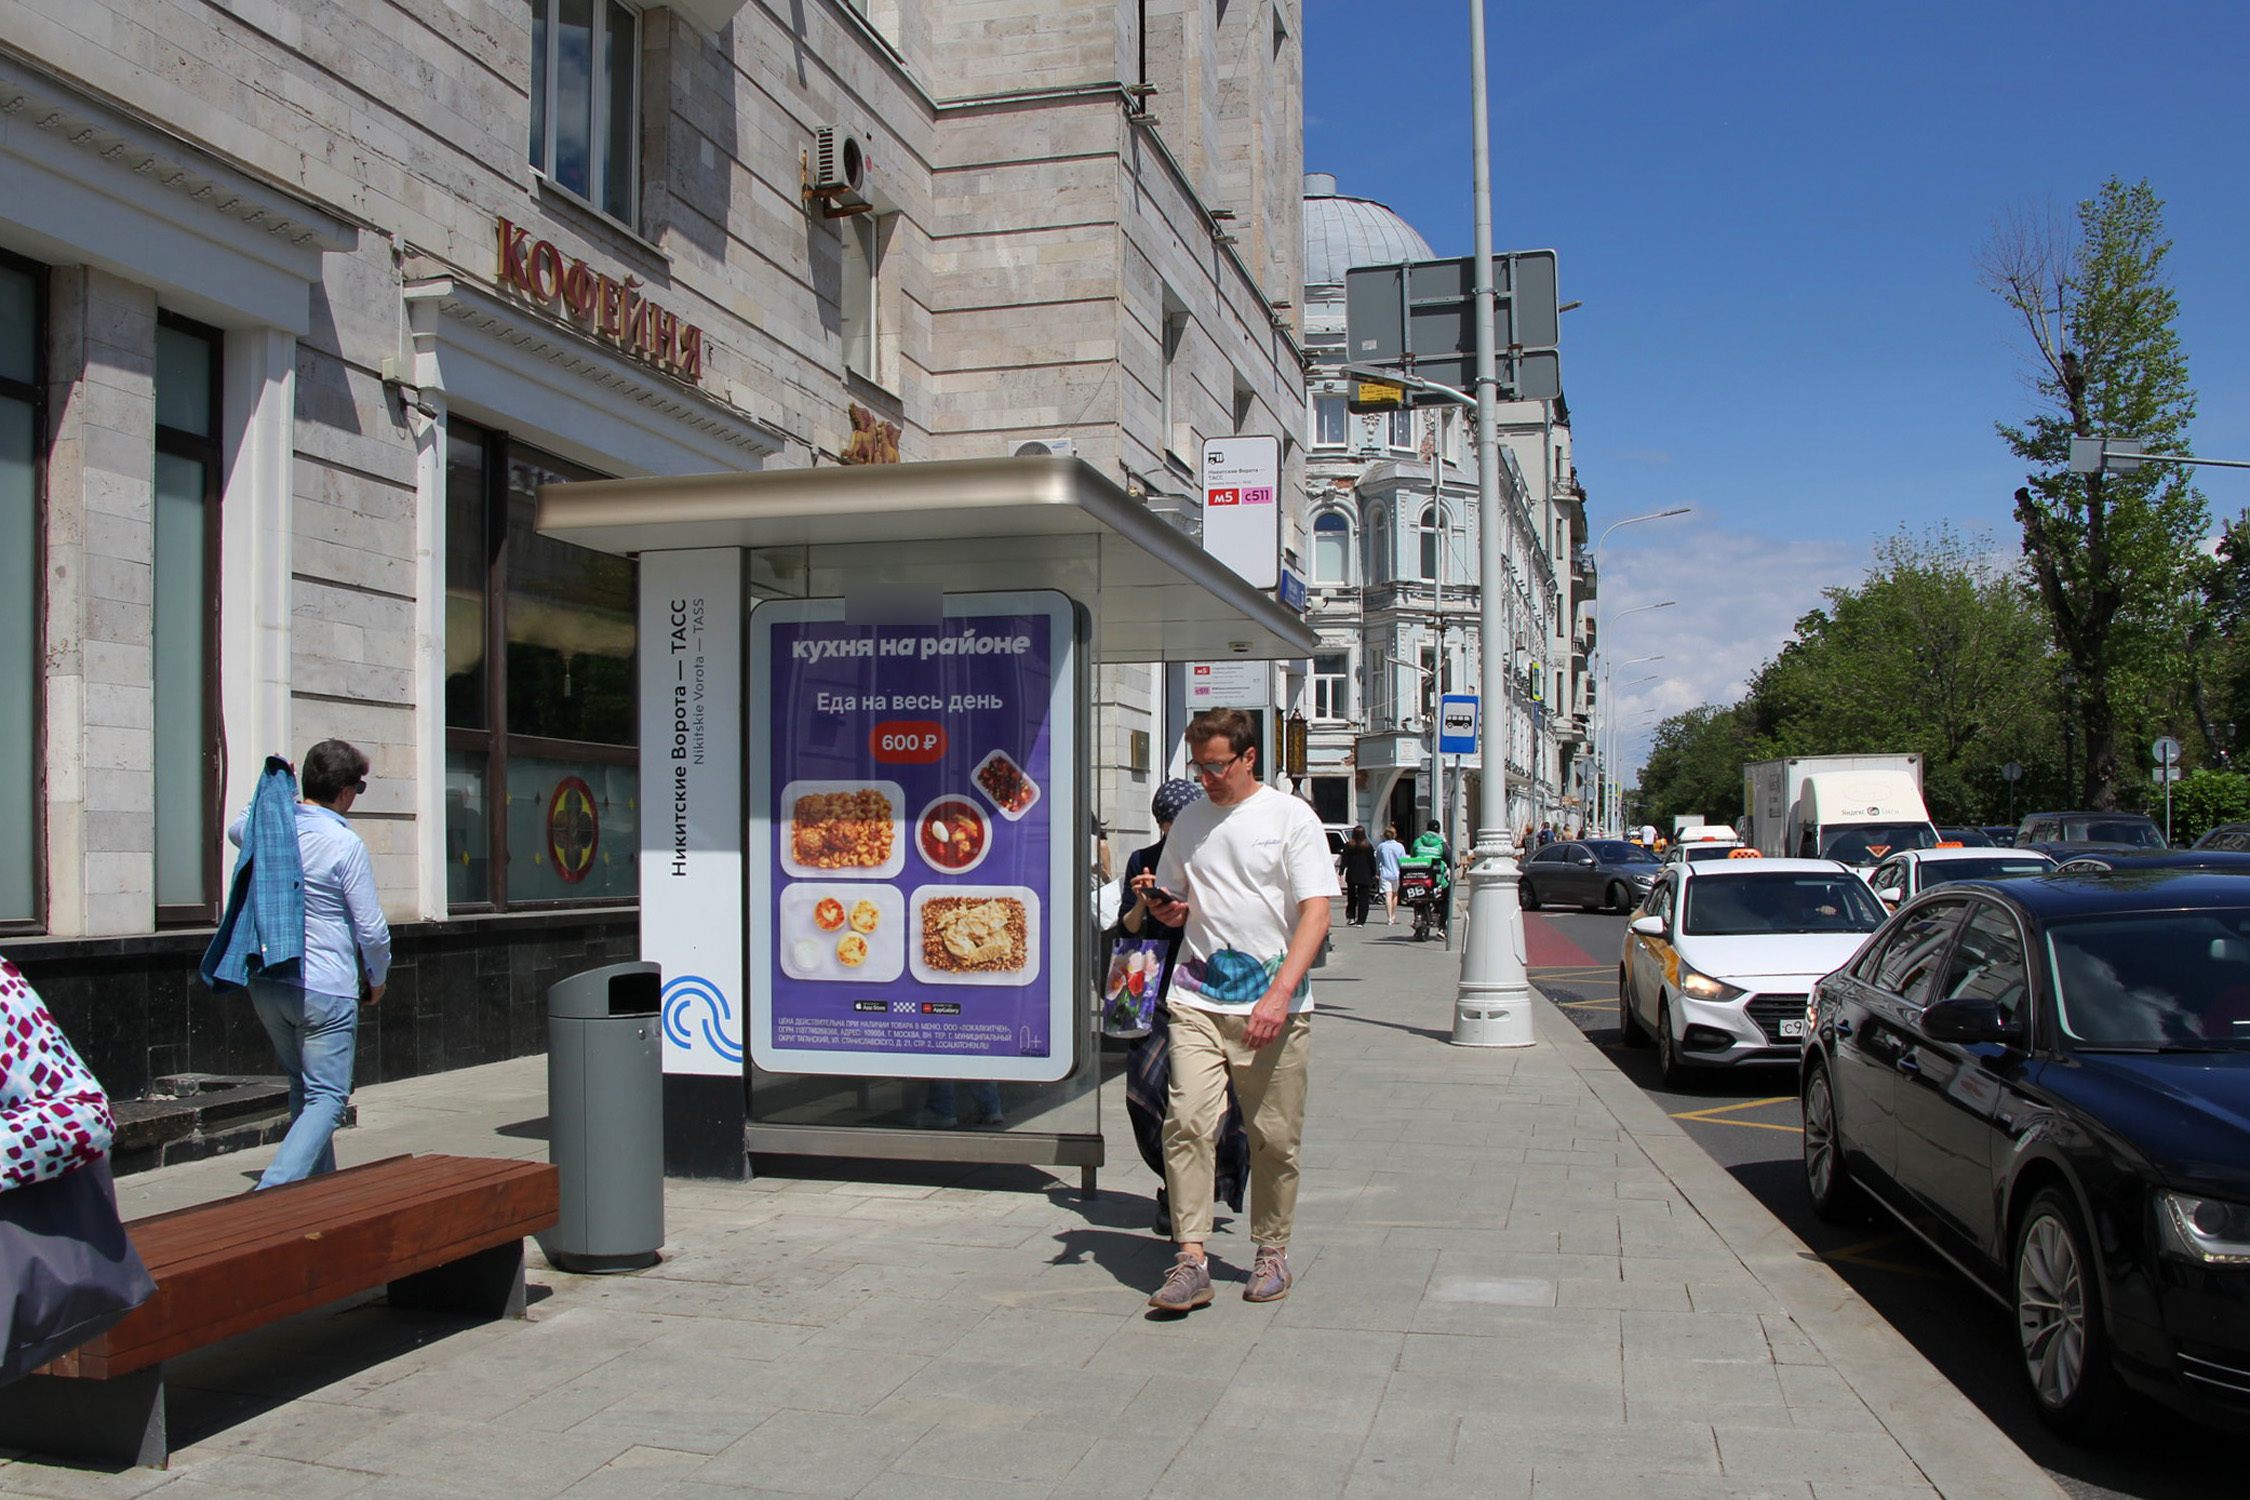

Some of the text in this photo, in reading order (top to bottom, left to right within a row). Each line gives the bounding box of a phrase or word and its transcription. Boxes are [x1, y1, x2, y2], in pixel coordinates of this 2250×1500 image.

[496, 216, 703, 383] КОФЕЙНЯ
[1245, 490, 1269, 501] с511
[671, 599, 687, 655] ТАСС
[693, 598, 705, 634] TASS
[792, 629, 1031, 664] кухня на районе
[693, 656, 705, 701] Vorota
[671, 686, 690, 759] Ворота
[817, 692, 1003, 714] Еда на весь день
[693, 705, 705, 766] Nikitskie
[882, 734, 920, 751] 600
[671, 767, 687, 877] Никитские
